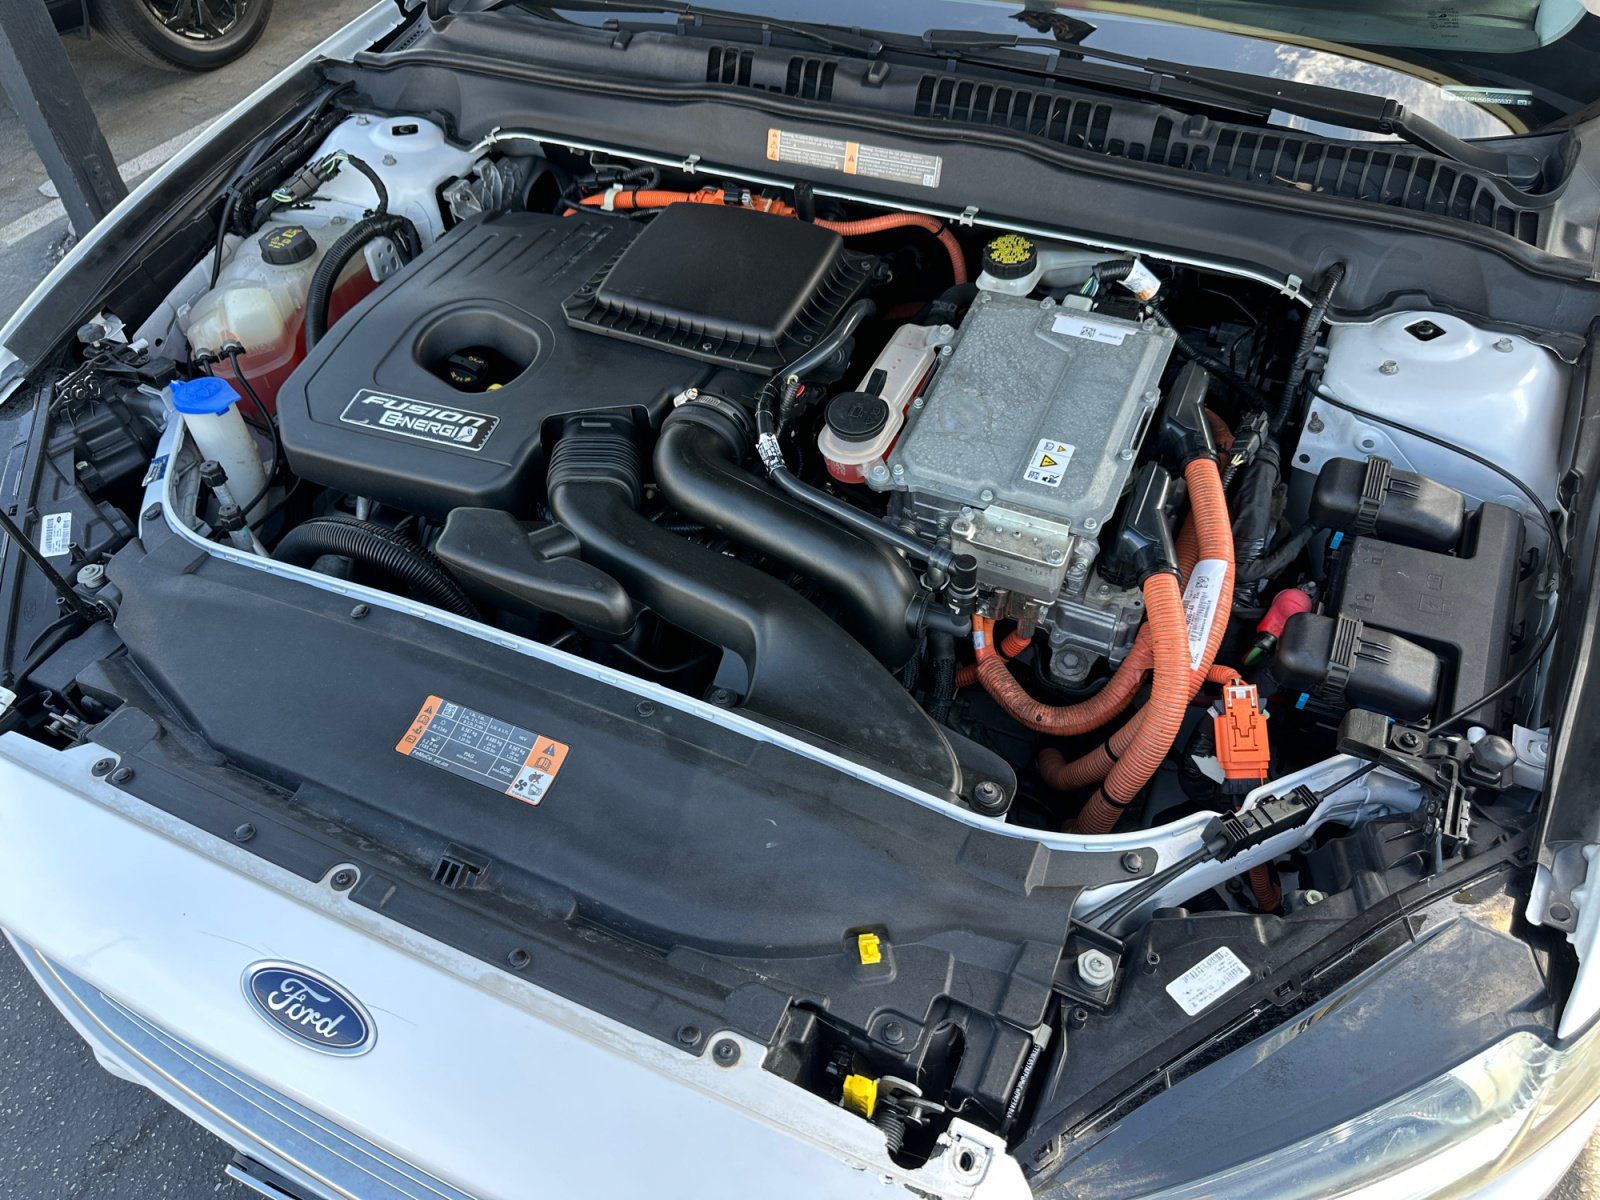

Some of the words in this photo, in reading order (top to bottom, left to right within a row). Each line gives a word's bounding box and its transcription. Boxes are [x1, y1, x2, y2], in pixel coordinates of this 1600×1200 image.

[362, 395, 487, 427] FUSION
[379, 410, 459, 438] ENERGI
[411, 749, 433, 761] FoMoCo
[463, 751, 475, 759] PAG
[500, 765, 512, 774] POE
[267, 977, 346, 1038] Ford
